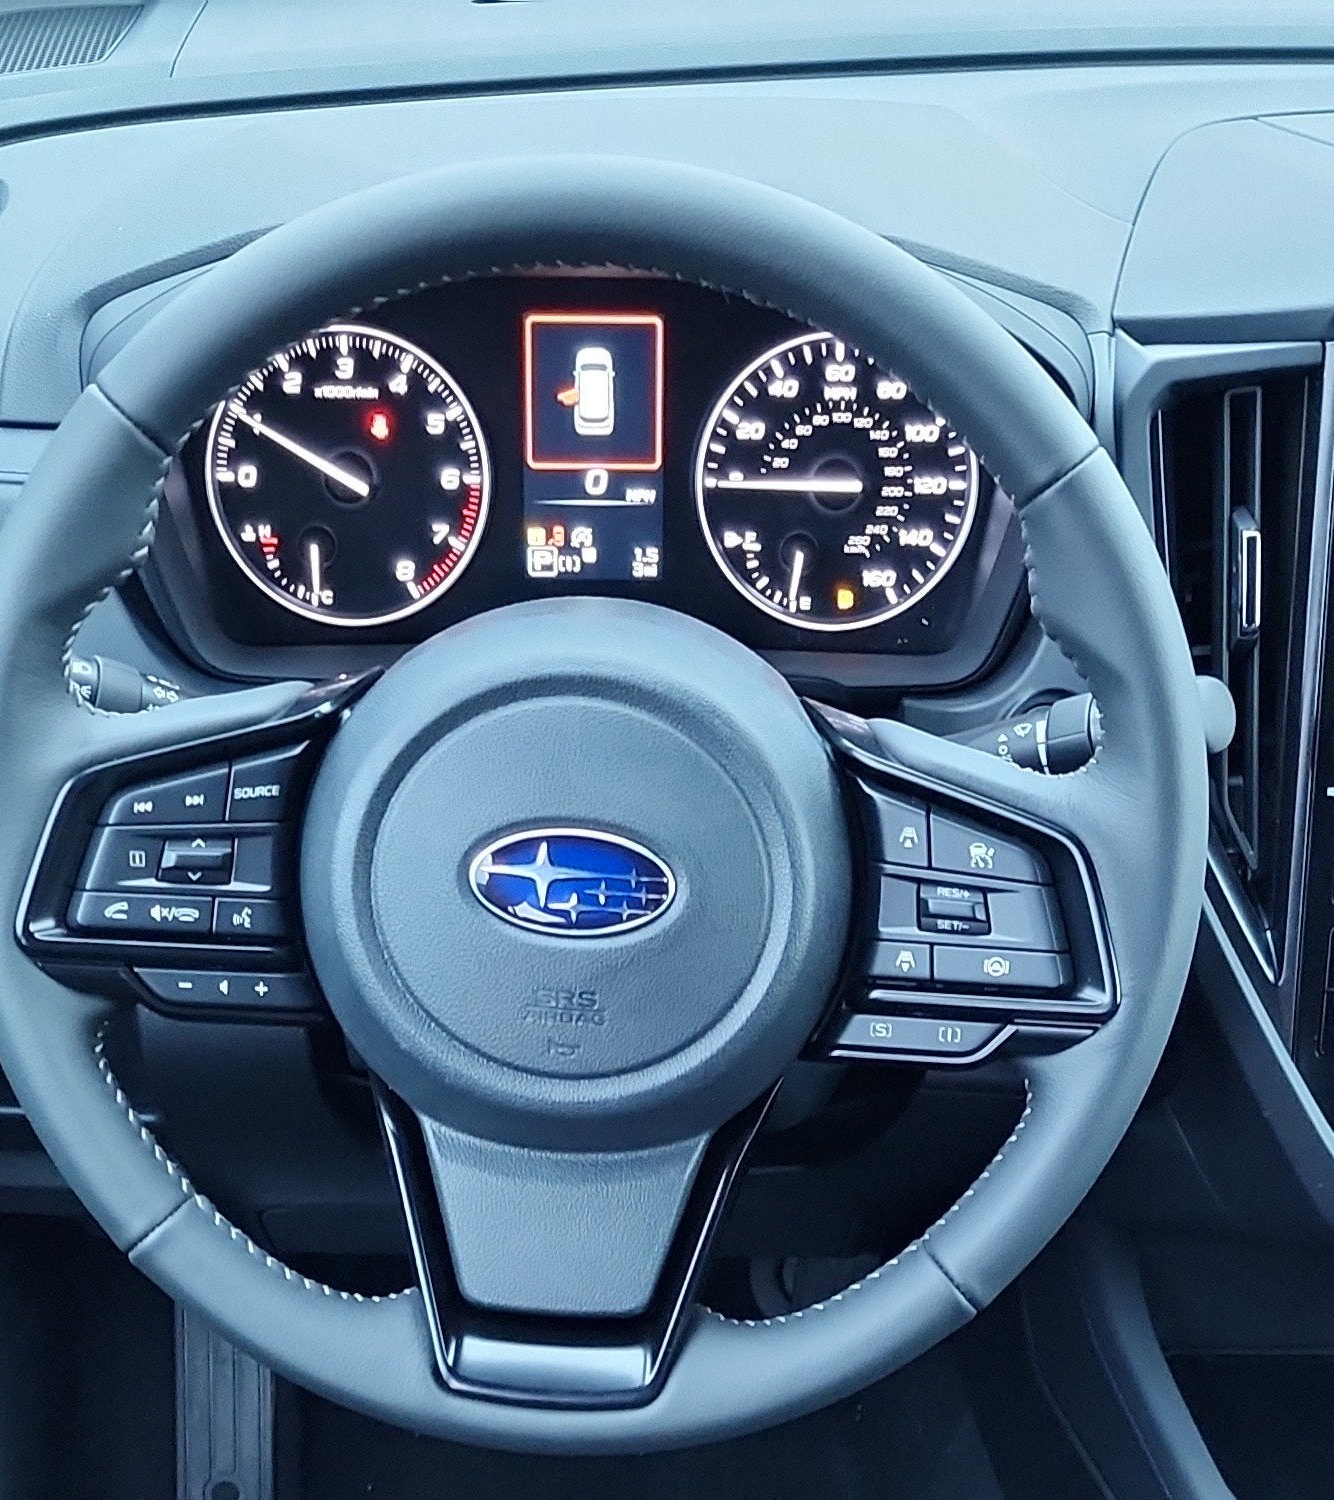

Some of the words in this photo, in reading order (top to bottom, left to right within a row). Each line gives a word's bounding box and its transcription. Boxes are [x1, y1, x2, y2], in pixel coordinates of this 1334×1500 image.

[335, 357, 354, 379] 3
[825, 364, 856, 383] 60
[282, 371, 302, 394] 2
[388, 374, 408, 396] 4
[768, 379, 799, 398] 40
[876, 381, 907, 400] 80
[426, 413, 445, 435] 5
[736, 421, 765, 441] 20
[905, 424, 940, 443] 100
[781, 438, 798, 450] 40
[772, 456, 789, 469] 20
[237, 465, 257, 488] 0
[440, 467, 460, 490] 6
[584, 468, 609, 496] 0
[914, 477, 947, 495] 120
[431, 522, 450, 545] 7
[899, 528, 933, 547] 140
[395, 560, 415, 581] 8
[532, 550, 553, 571] P
[862, 569, 897, 588] 160
[233, 784, 280, 800] SOURCE
[534, 987, 599, 1008] SRS
